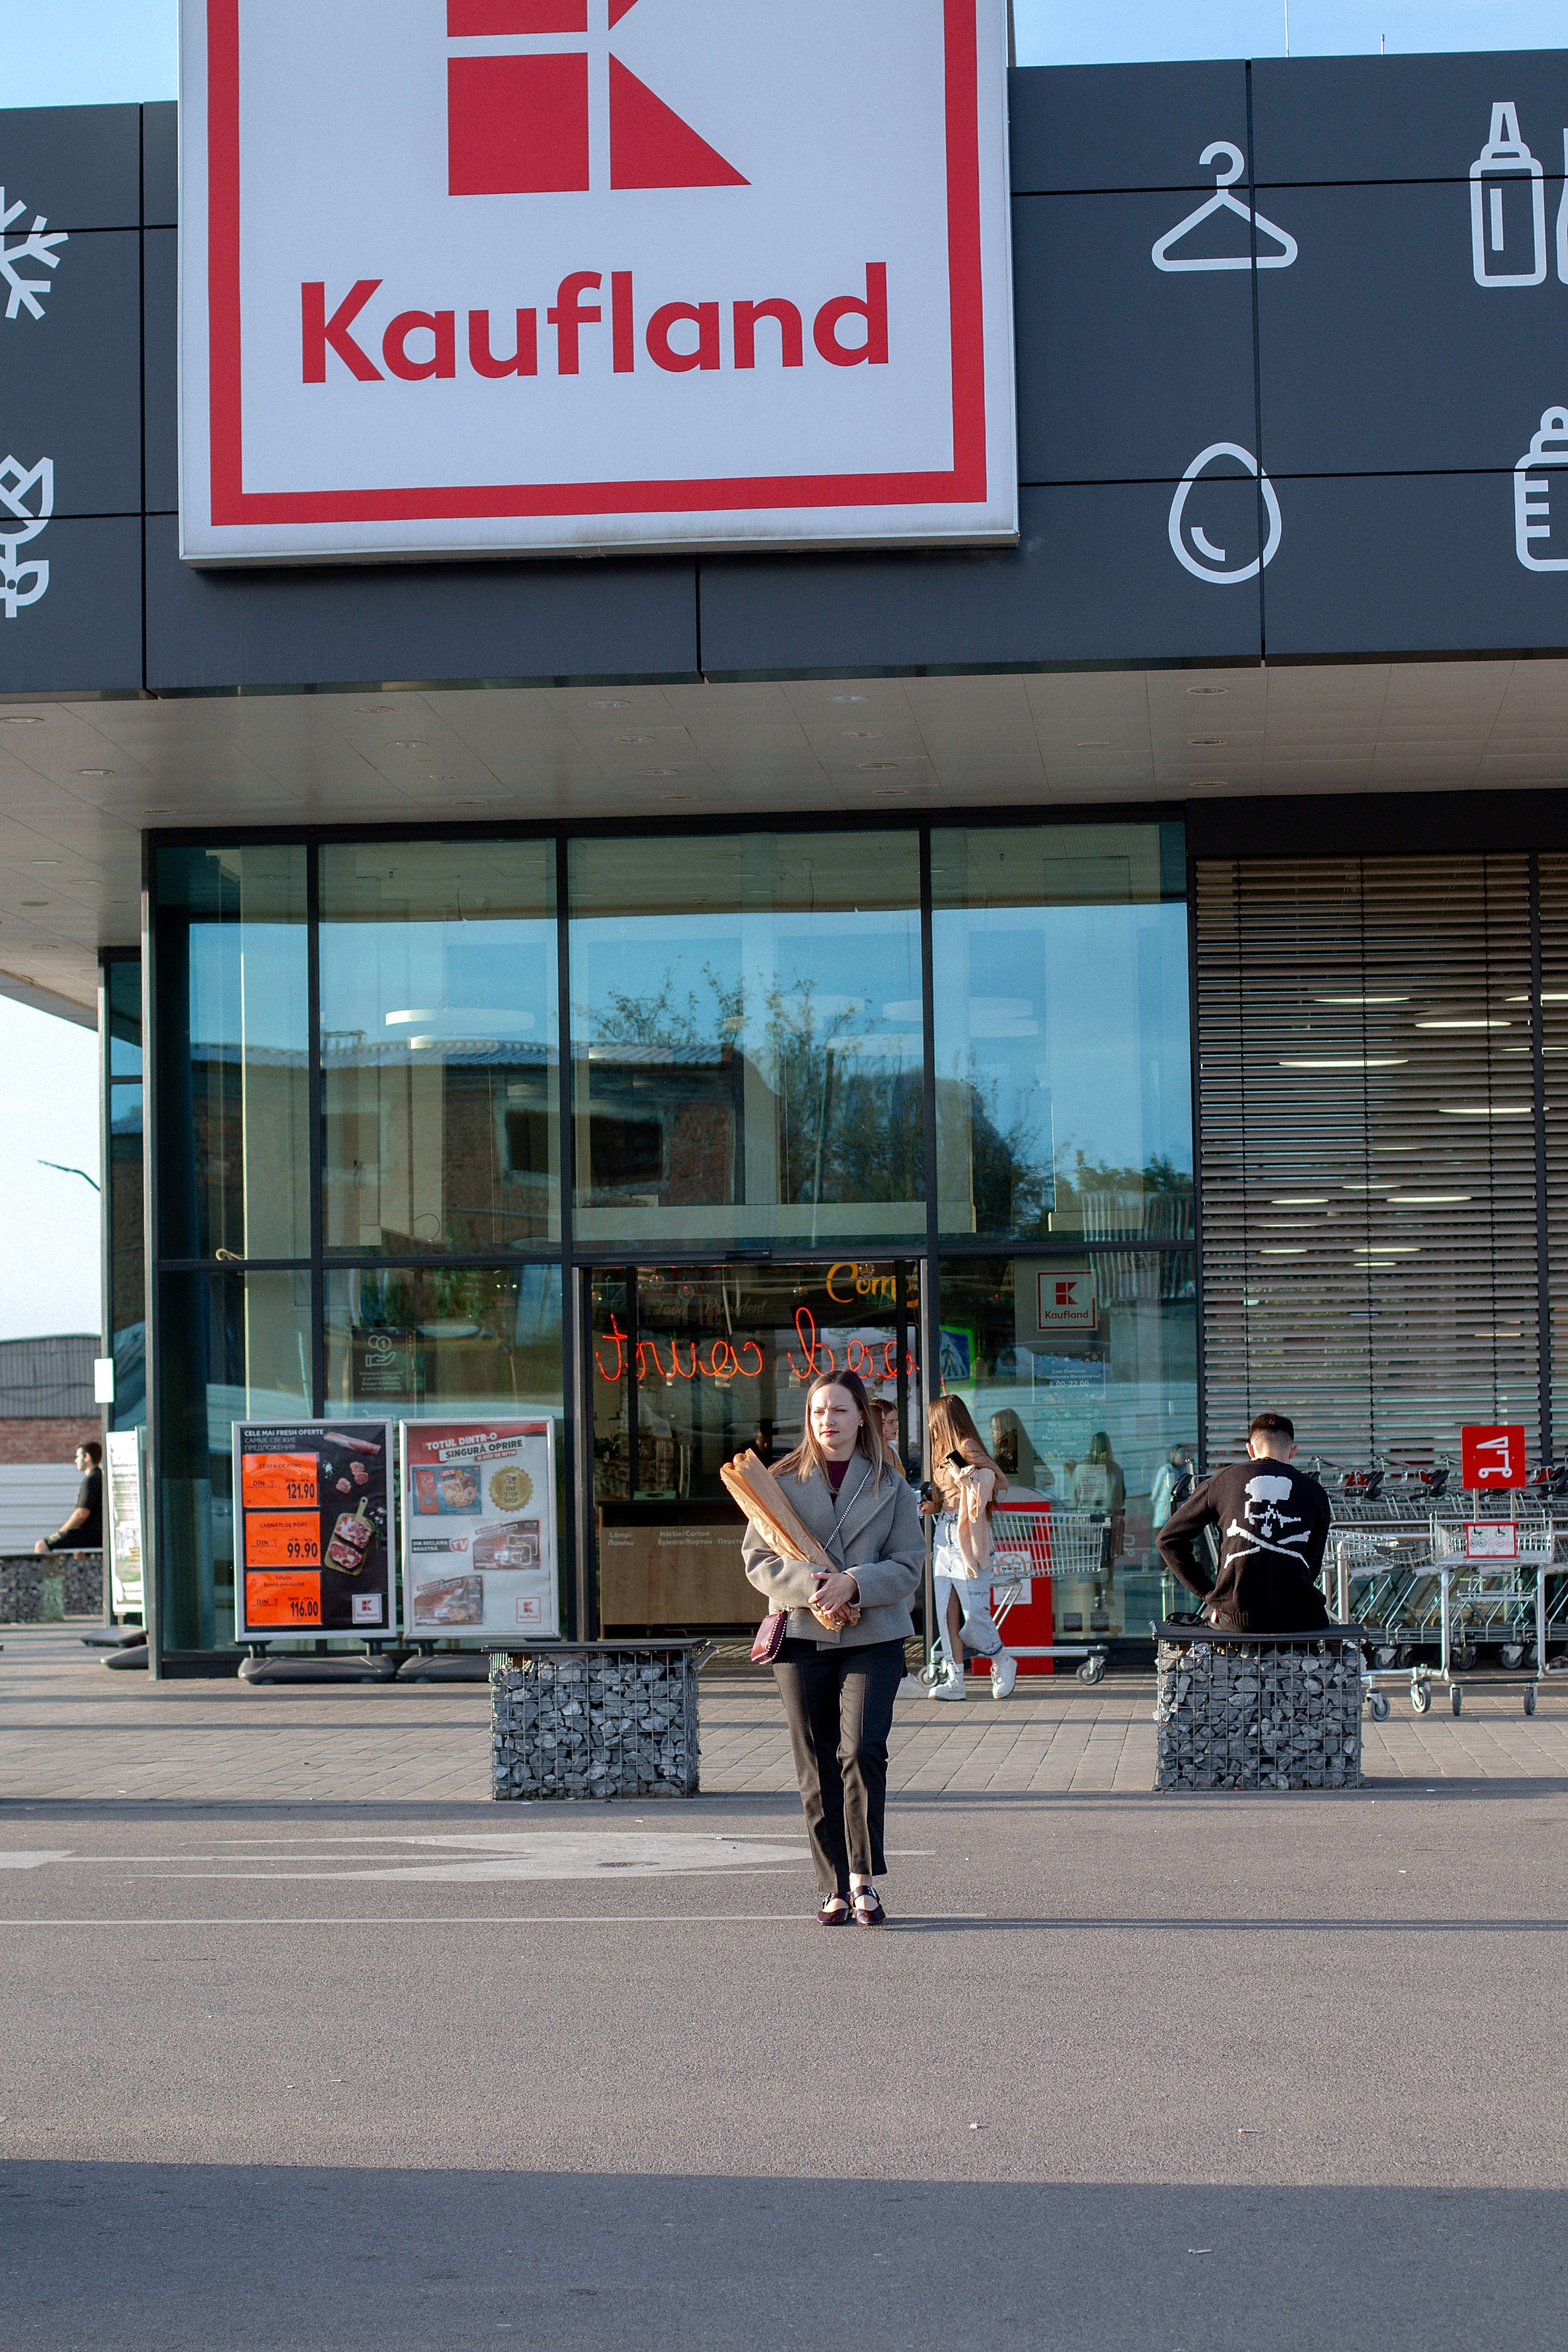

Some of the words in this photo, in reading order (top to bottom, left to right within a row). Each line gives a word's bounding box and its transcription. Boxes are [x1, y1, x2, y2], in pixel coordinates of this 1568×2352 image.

[301, 262, 888, 383] Kaufland
[1045, 1311, 1089, 1319] Kaufland
[426, 1438, 457, 1450] TOTUL
[459, 1432, 497, 1446] DINTR-O
[446, 1444, 486, 1459] SINGURĂ
[489, 1440, 523, 1452] OPRIRE
[287, 1482, 315, 1499] 121.90
[287, 1542, 318, 1558] 99.90
[451, 1540, 467, 1550] TV
[290, 1600, 318, 1618] 116.00
